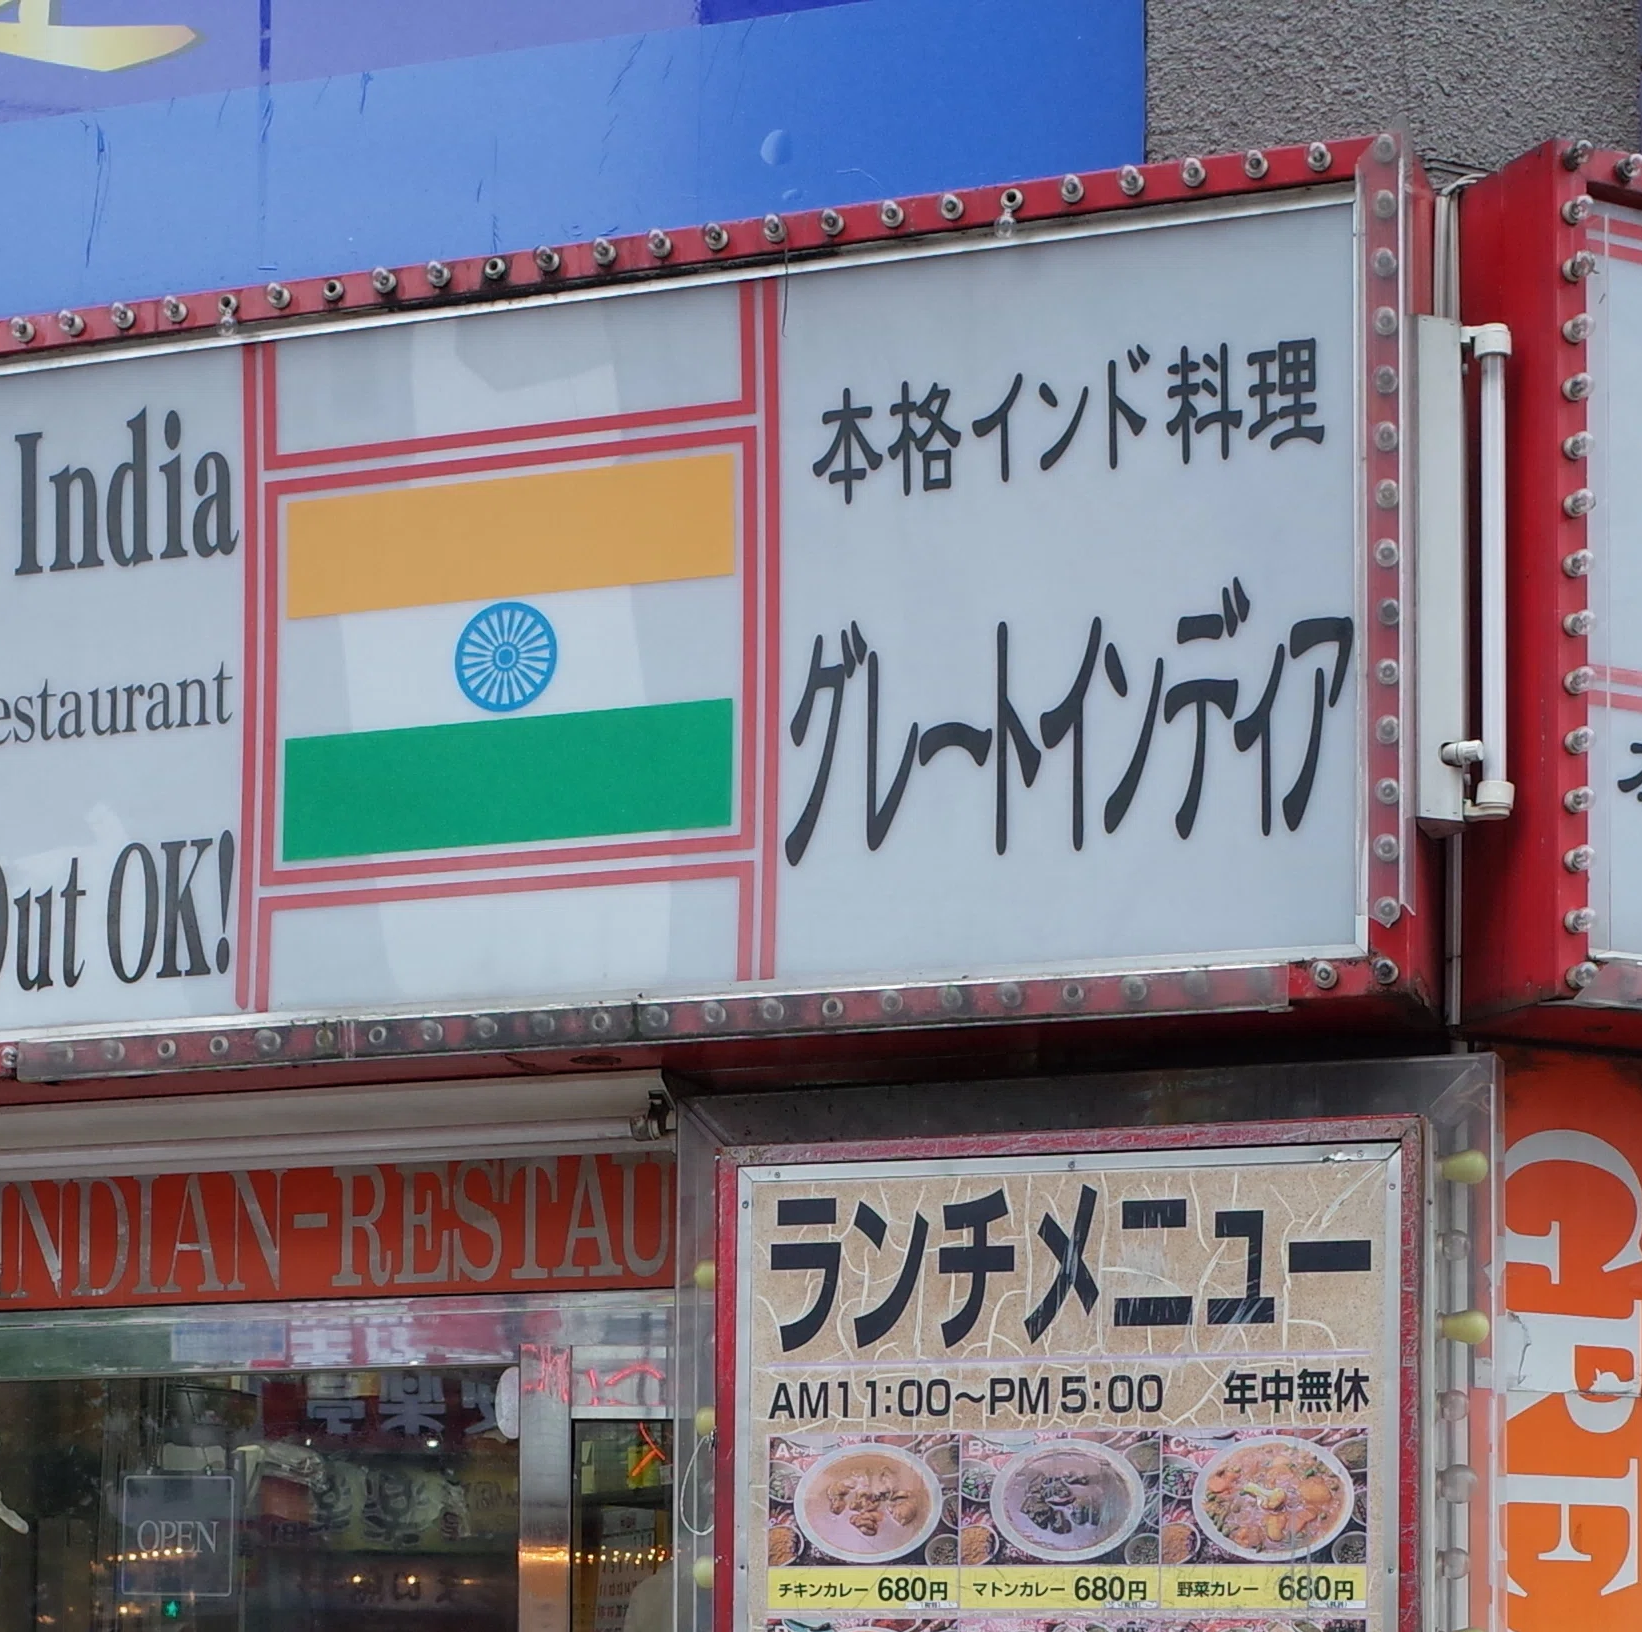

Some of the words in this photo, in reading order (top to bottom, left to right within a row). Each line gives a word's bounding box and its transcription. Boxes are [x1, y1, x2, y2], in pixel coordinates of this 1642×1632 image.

[811, 337, 1327, 504] 本格インド料理
[13, 406, 238, 576] India
[785, 575, 1353, 867] グレートインディア
[105, 829, 233, 982] OK!
[770, 1185, 1372, 1353] ランチメニュー
[1224, 1368, 1369, 1414] 年中無休
[137, 1520, 218, 1553] OPEN
[778, 1584, 868, 1598] チキンカレー
[878, 1577, 948, 1601] 680円
[973, 1583, 1065, 1598] マトンカレー
[1074, 1576, 1147, 1601] 680円
[1178, 1582, 1258, 1598] 野菜カレー
[1278, 1576, 1354, 1601] 680円
